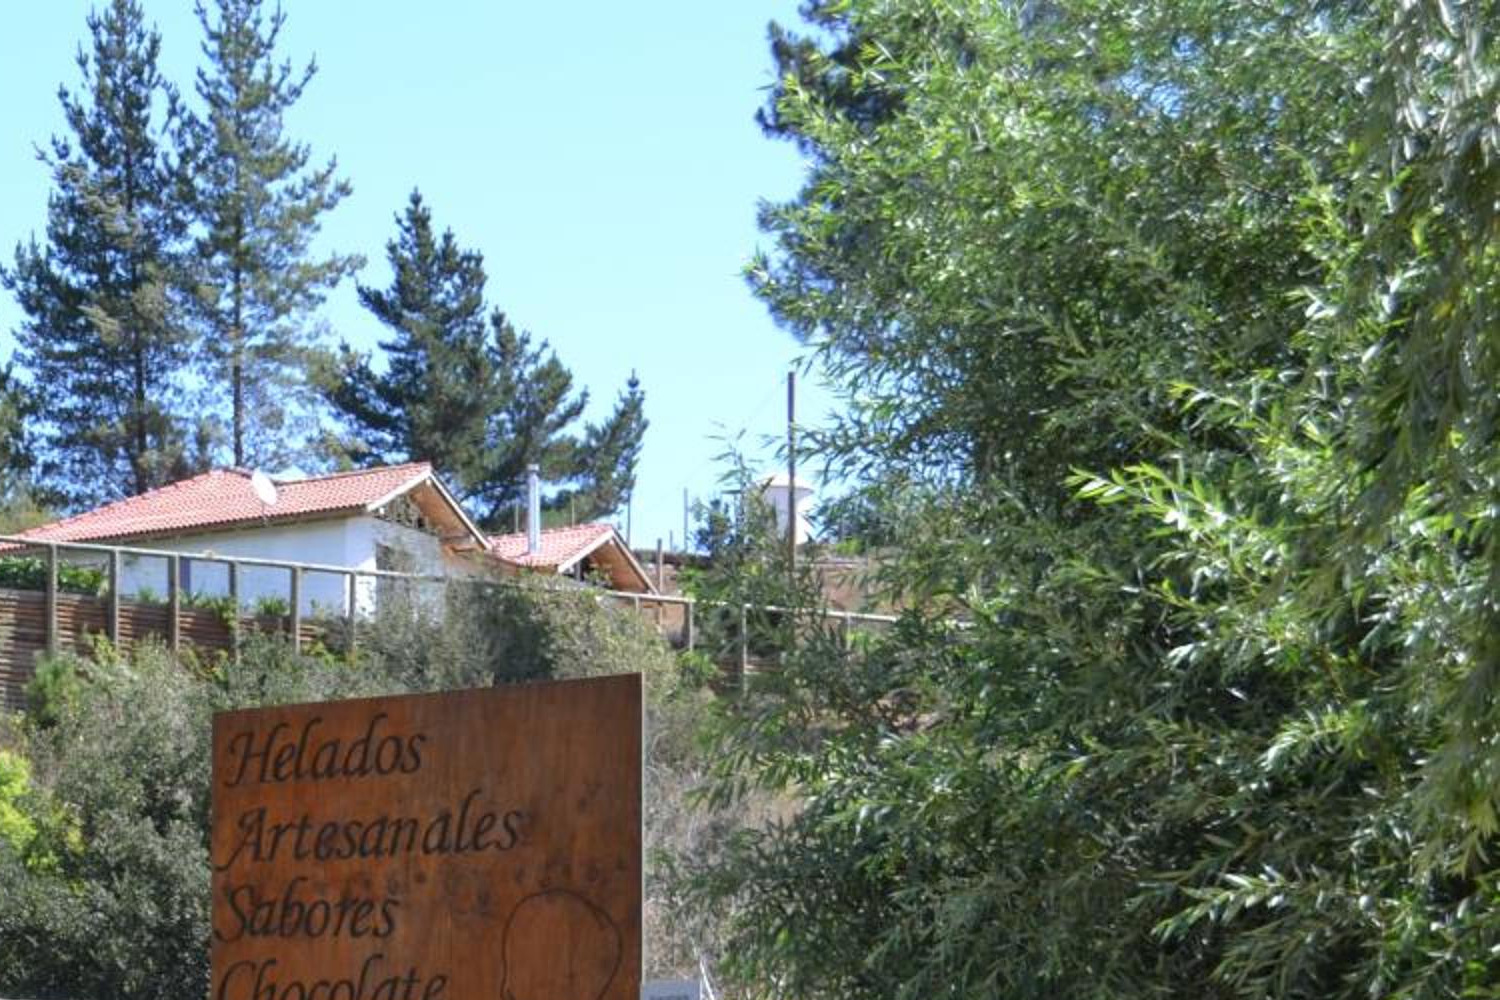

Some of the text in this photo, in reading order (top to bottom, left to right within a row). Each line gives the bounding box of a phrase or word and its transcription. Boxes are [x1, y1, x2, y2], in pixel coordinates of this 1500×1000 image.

[224, 713, 426, 788] Helados
[215, 789, 524, 871] Artesanales
[214, 877, 401, 943] Sabores
